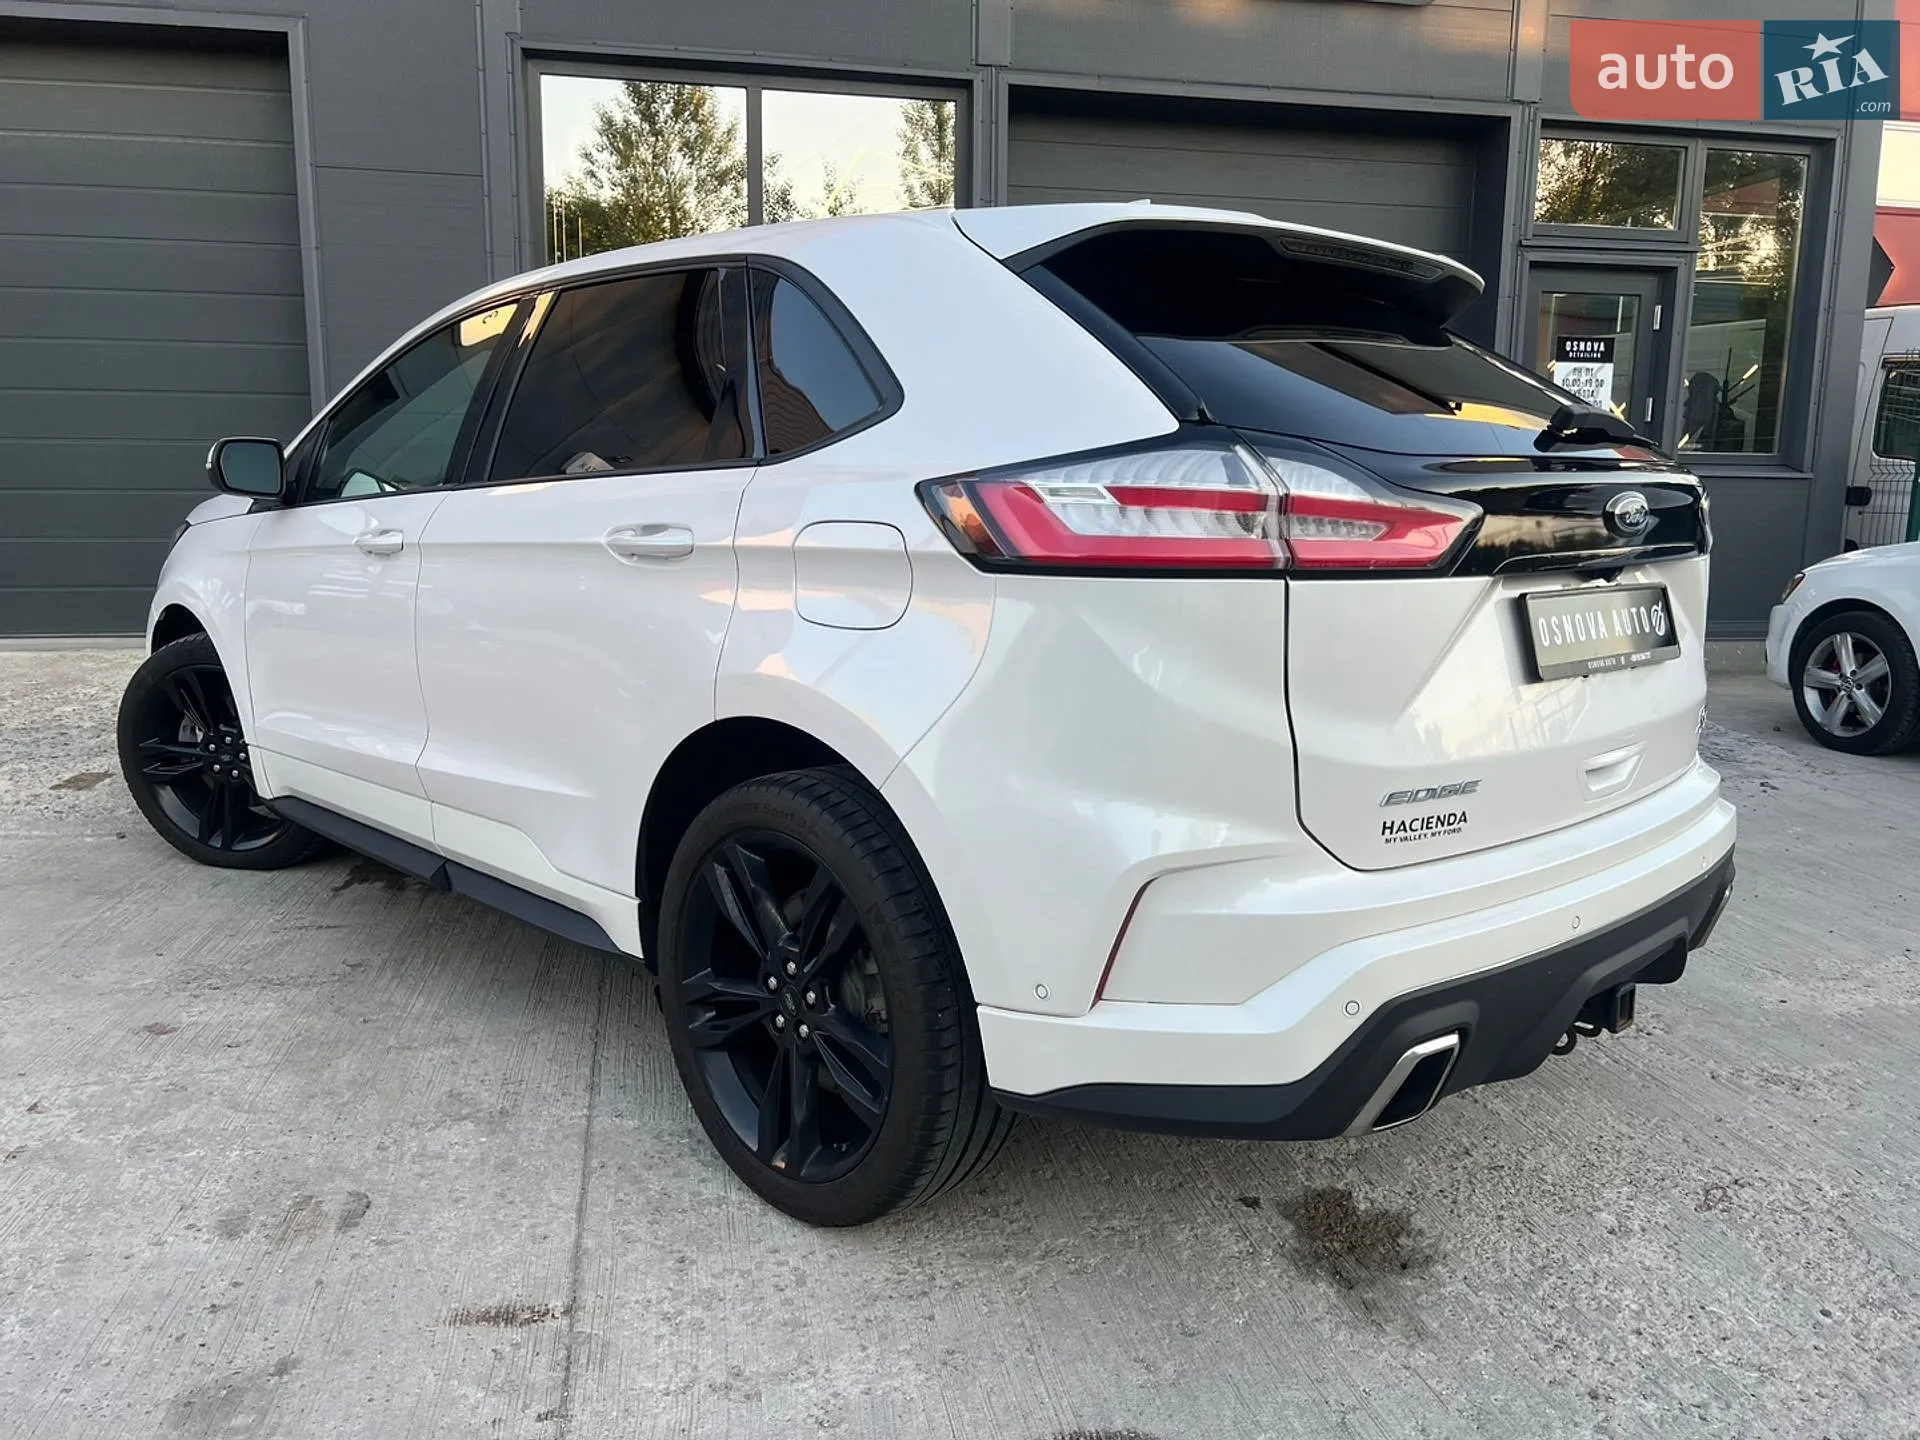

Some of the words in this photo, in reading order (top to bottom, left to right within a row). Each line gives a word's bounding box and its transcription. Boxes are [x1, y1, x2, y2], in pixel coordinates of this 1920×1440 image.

[1565, 341, 1605, 352] OSNOVA
[1538, 610, 1609, 647] OSNOVA
[1612, 605, 1651, 637] AUTO
[1380, 780, 1482, 807] EDGE
[1381, 811, 1467, 836] HACIENDA
